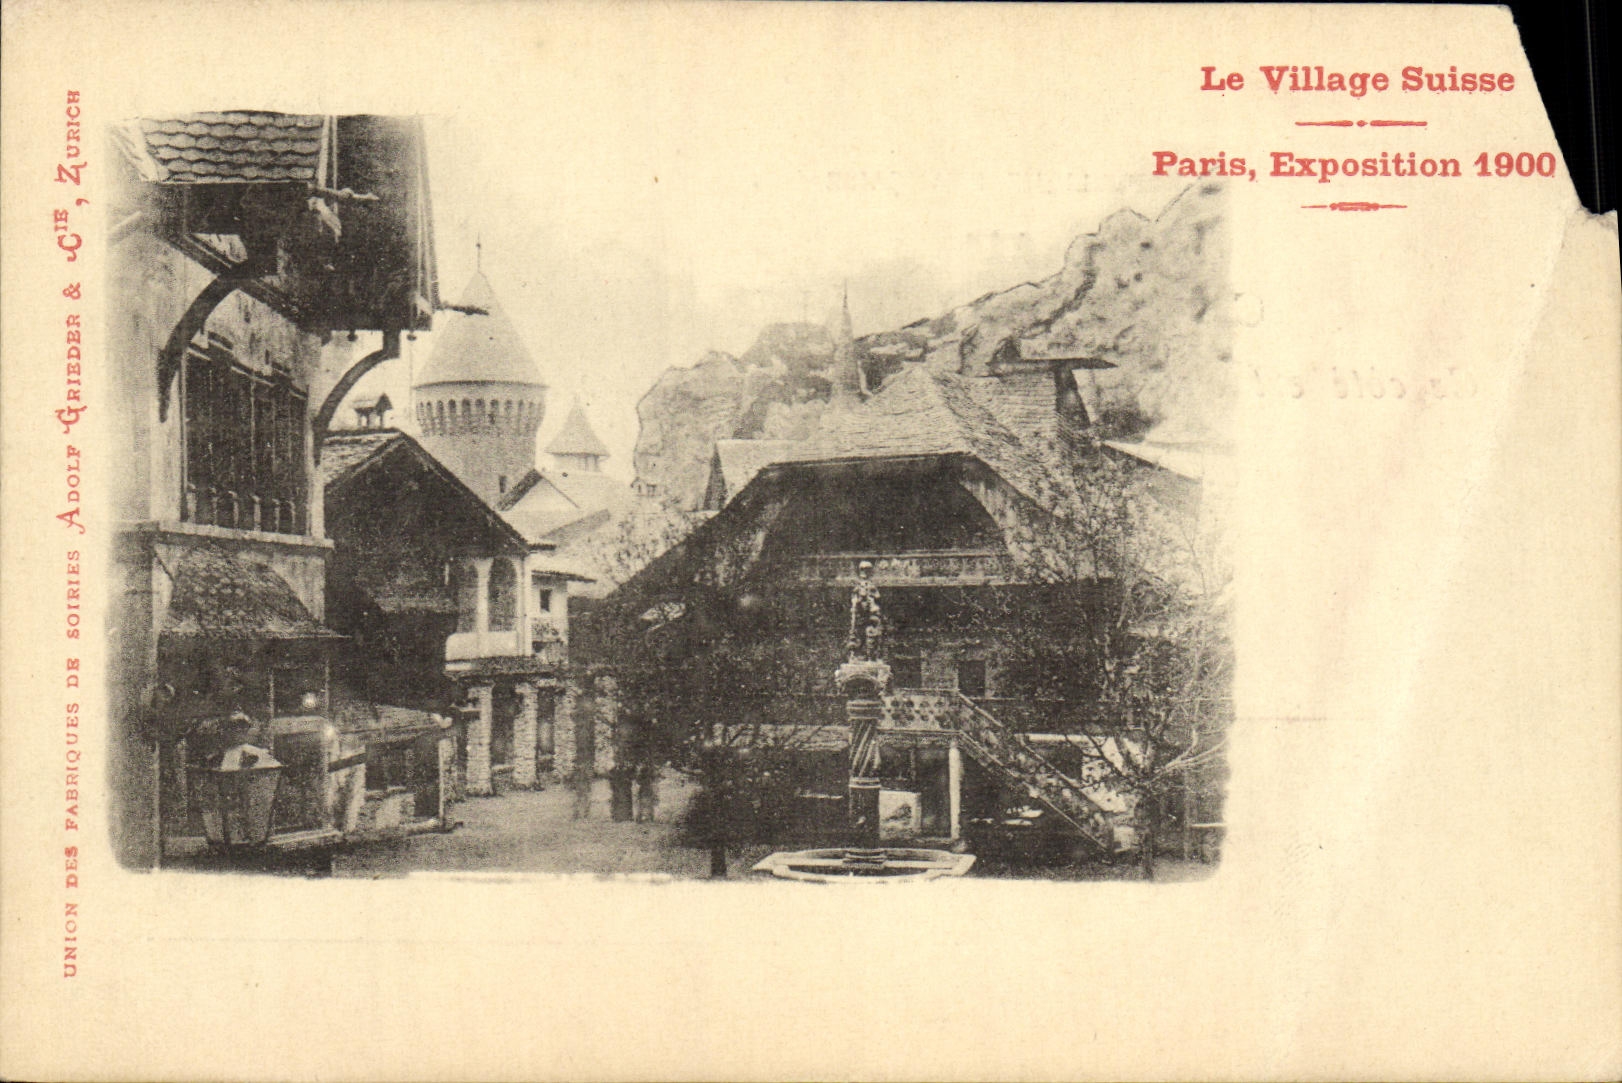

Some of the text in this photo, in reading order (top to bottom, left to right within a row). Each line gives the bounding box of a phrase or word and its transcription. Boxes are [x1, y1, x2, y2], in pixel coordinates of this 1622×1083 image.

[1200, 65, 1515, 98] Le Village Suisse
[1152, 151, 1556, 183] Paris, Exposition 1900
[62, 283, 81, 300] &
[66, 551, 80, 639] SOIRIES
[67, 657, 80, 687] DE
[65, 704, 79, 830] FABRIQUES
[65, 846, 79, 890] DES
[64, 903, 79, 978] UNION
